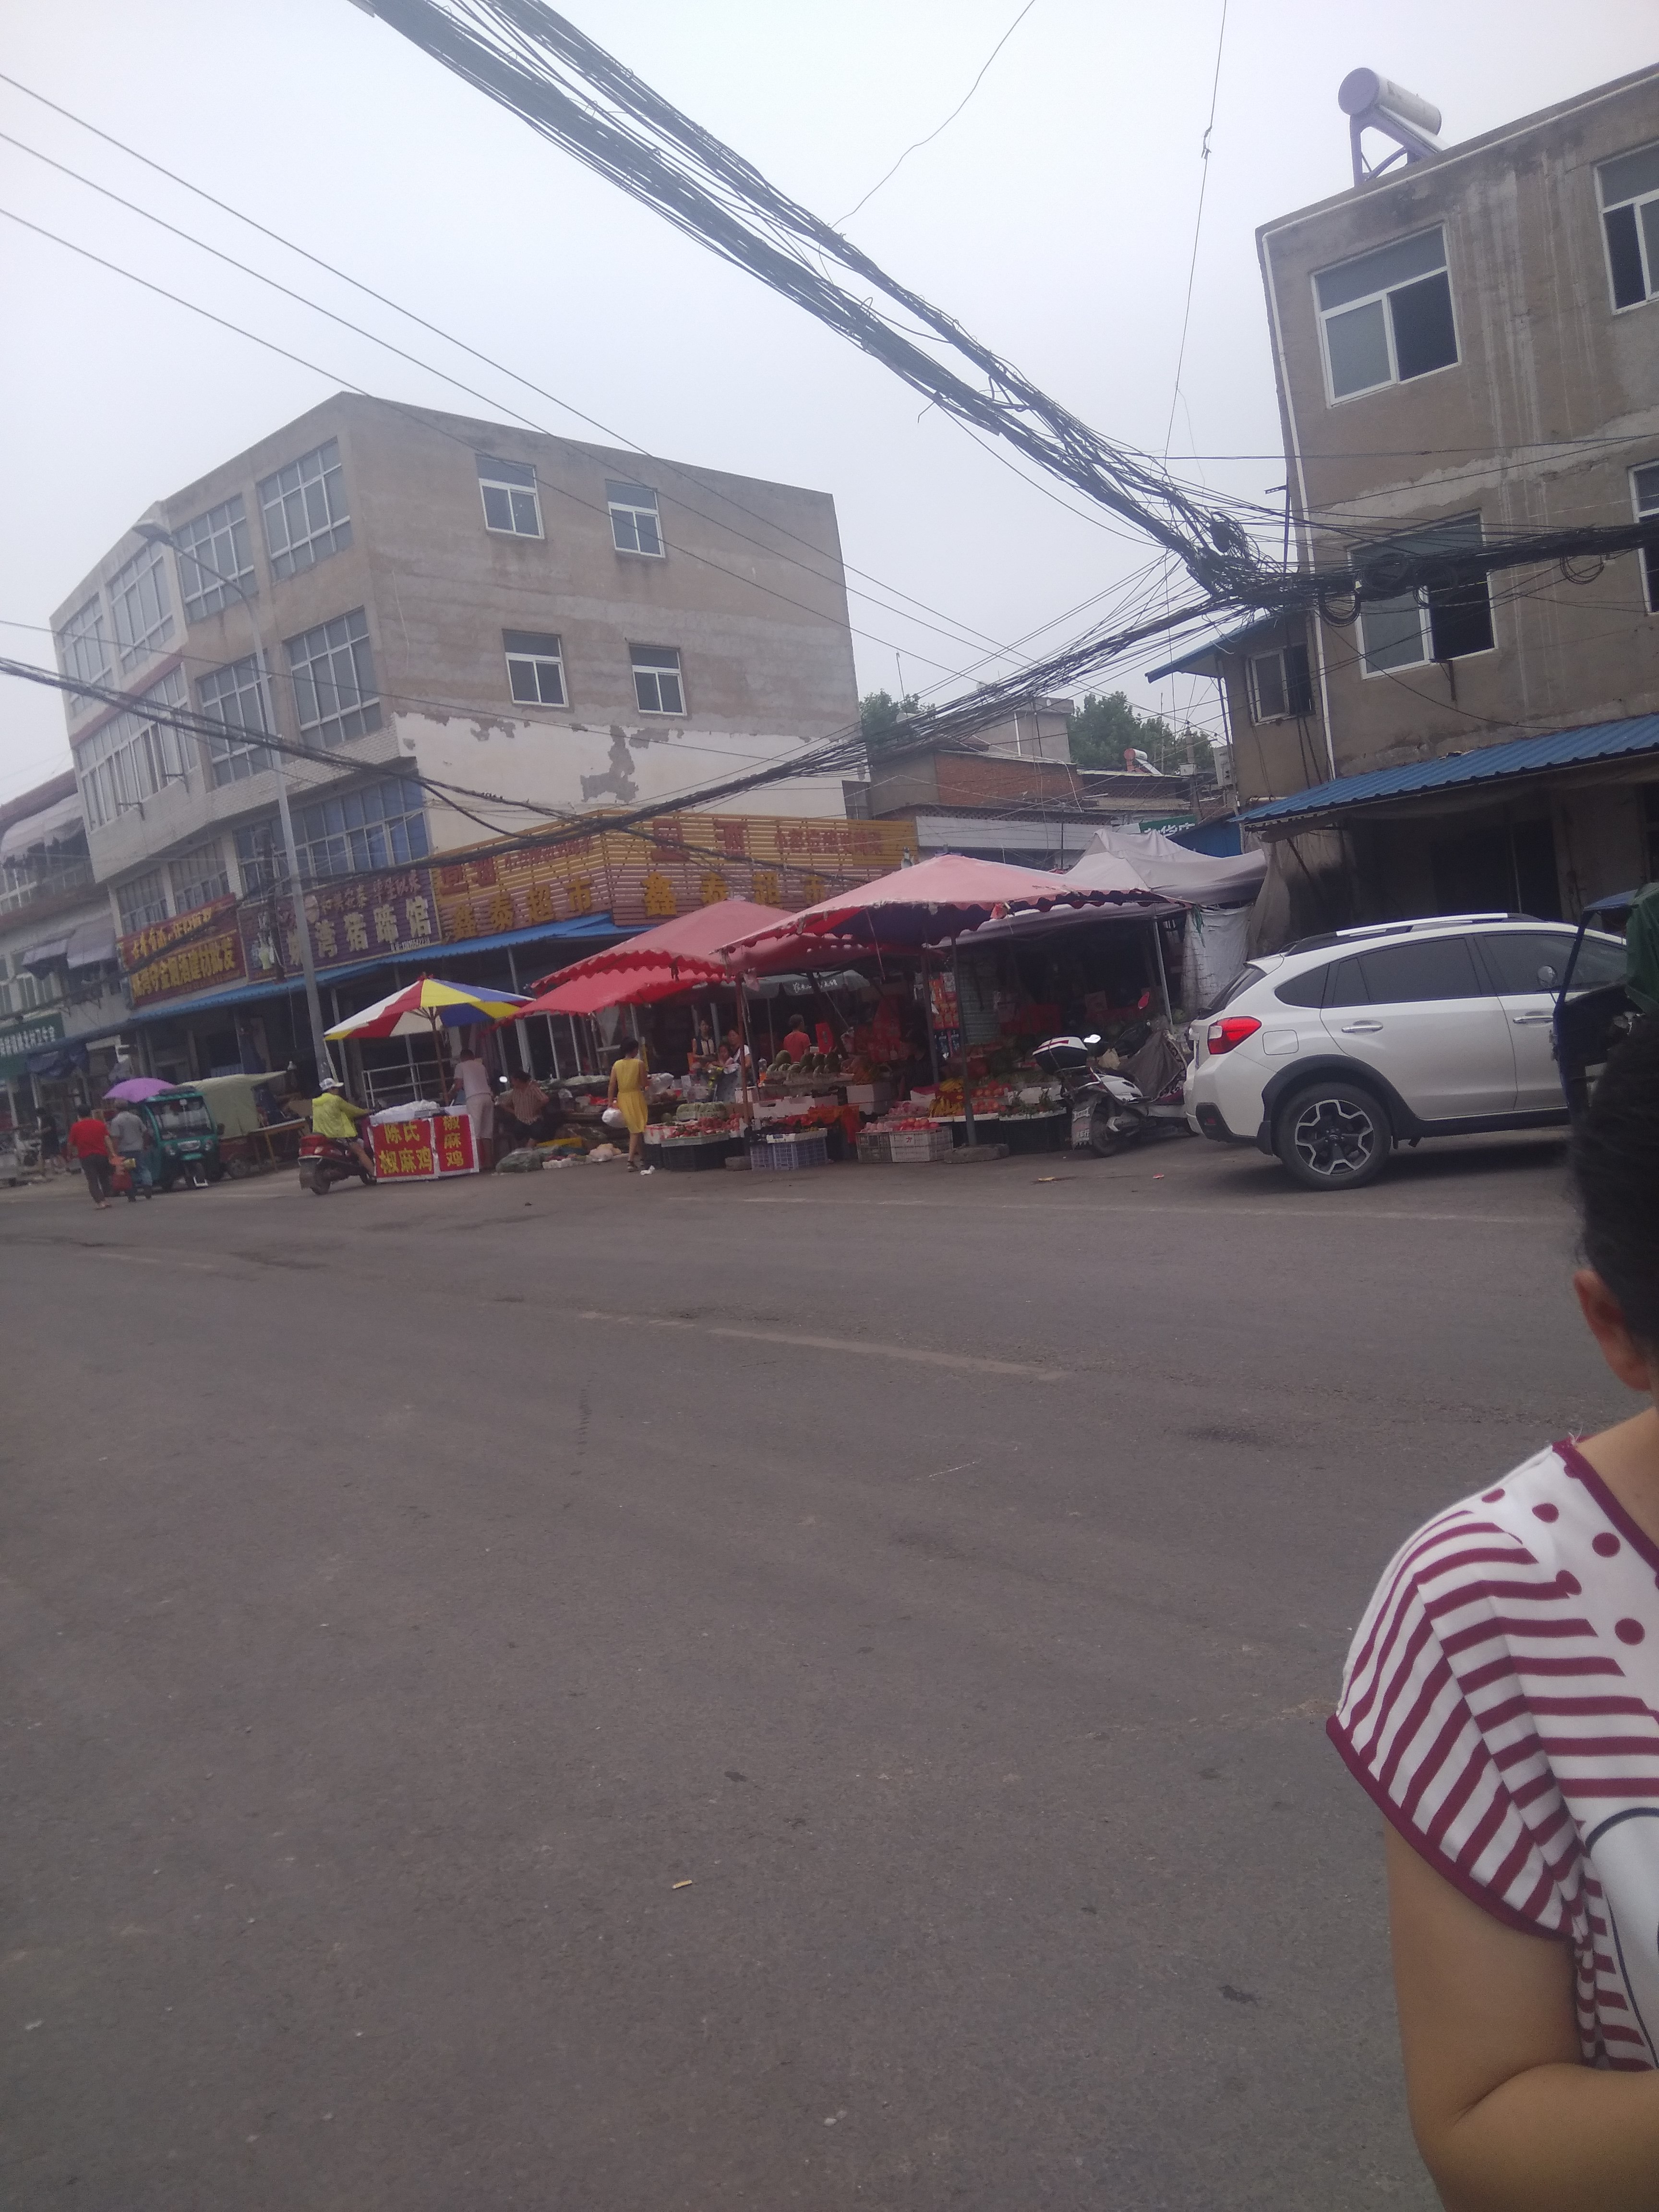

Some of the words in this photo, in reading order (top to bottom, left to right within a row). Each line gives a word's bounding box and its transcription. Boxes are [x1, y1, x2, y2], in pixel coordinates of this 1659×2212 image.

[385, 1120, 421, 1144] 陈氏
[379, 1146, 432, 1174] 椒麻鸡
